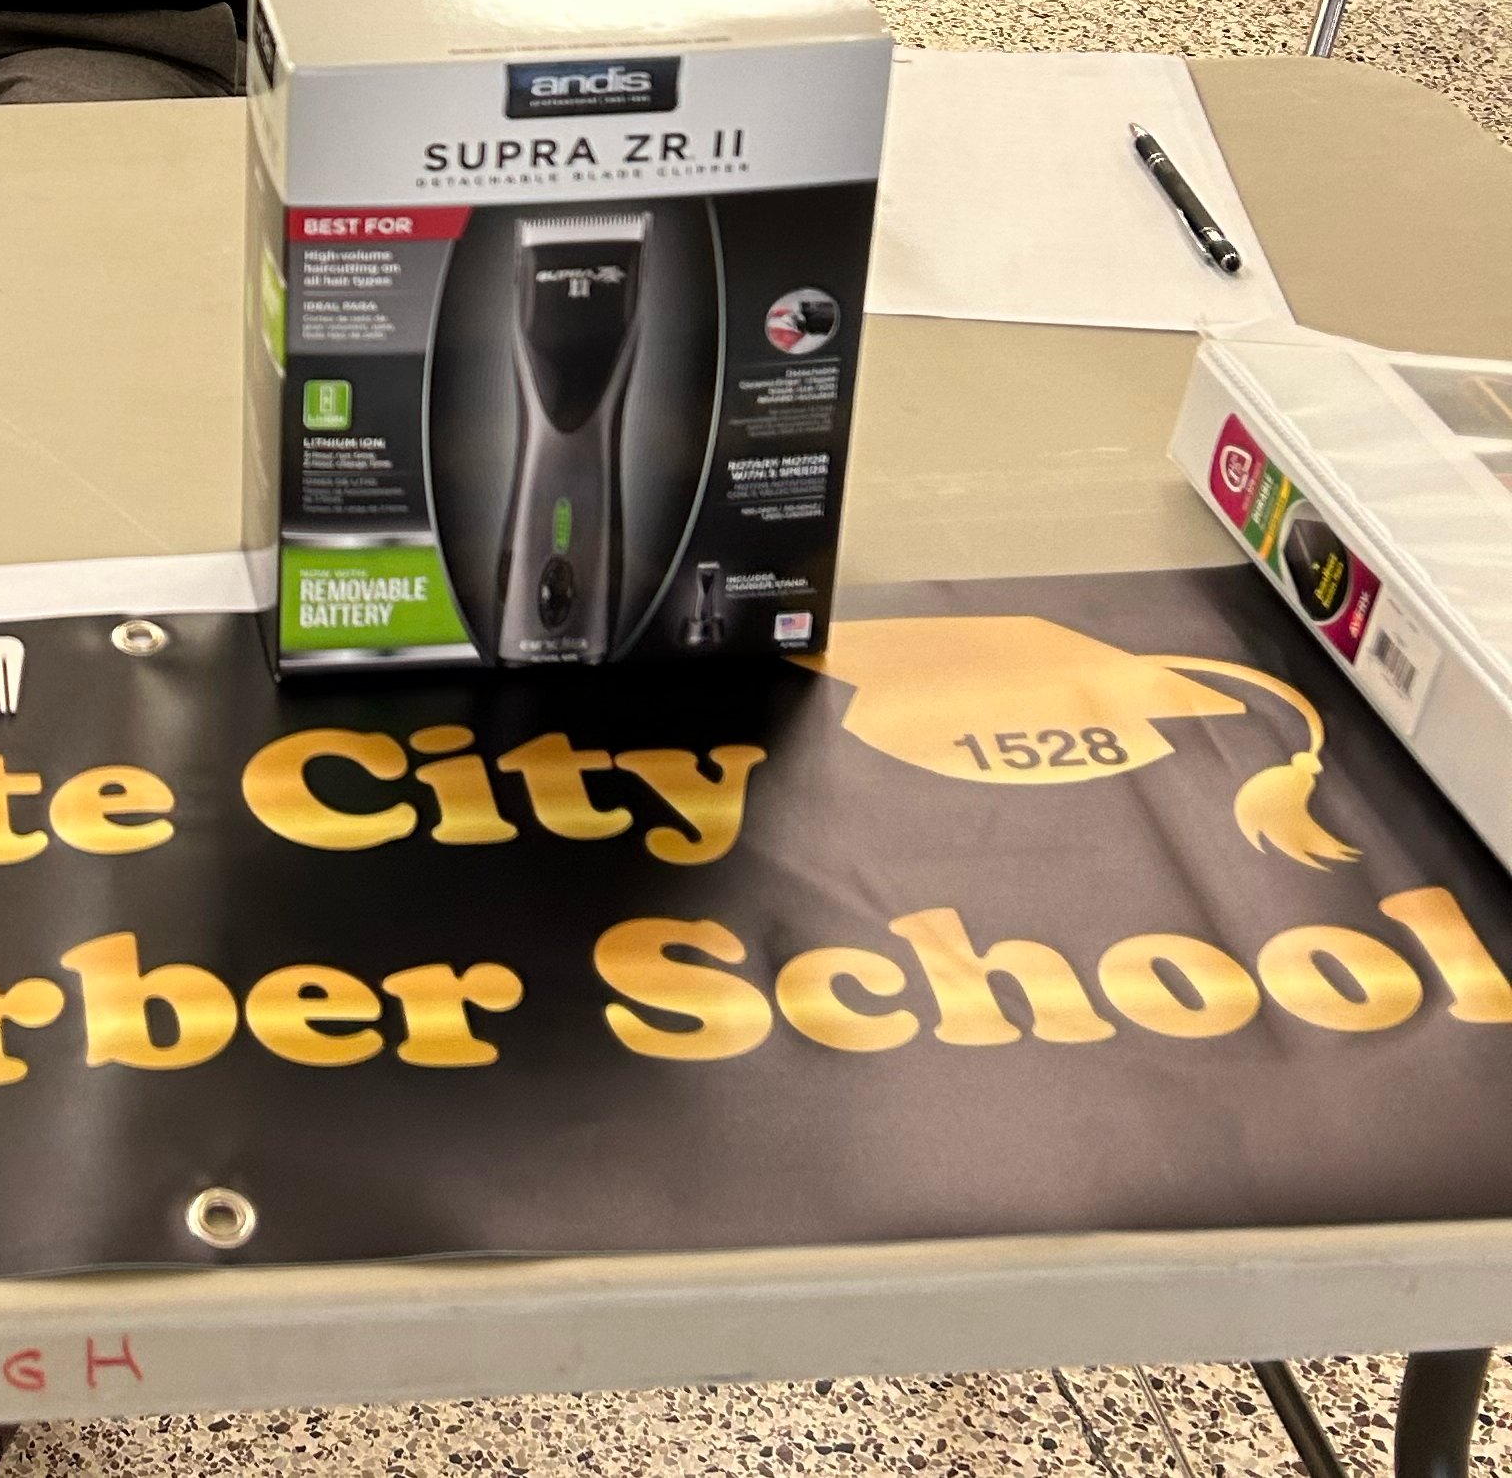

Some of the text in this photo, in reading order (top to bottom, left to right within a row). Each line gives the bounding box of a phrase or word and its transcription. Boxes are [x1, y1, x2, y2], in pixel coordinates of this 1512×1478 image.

[530, 66, 652, 97] andis
[424, 128, 744, 172] SUPRA ZR II
[415, 162, 750, 188] DETACHABLE BLADE CLIPPER
[303, 216, 414, 235] BEST FOR
[304, 250, 393, 262] High-volume
[303, 263, 401, 275] haircutting on
[303, 275, 393, 288] all hair types
[303, 301, 378, 311] IDEAL PARA
[303, 437, 357, 450] LITHIUM
[728, 453, 830, 471] ROTARY MOTOR
[731, 468, 767, 481] WITH
[779, 464, 829, 478] SPEEDS
[1251, 473, 1274, 525] DURABLE
[300, 576, 428, 602] REMOVABLE
[726, 573, 776, 583] INCLUDES
[299, 602, 394, 629] BATTERY
[952, 726, 1130, 772] 1528
[240, 725, 768, 866] City
[591, 886, 1512, 1062] School
